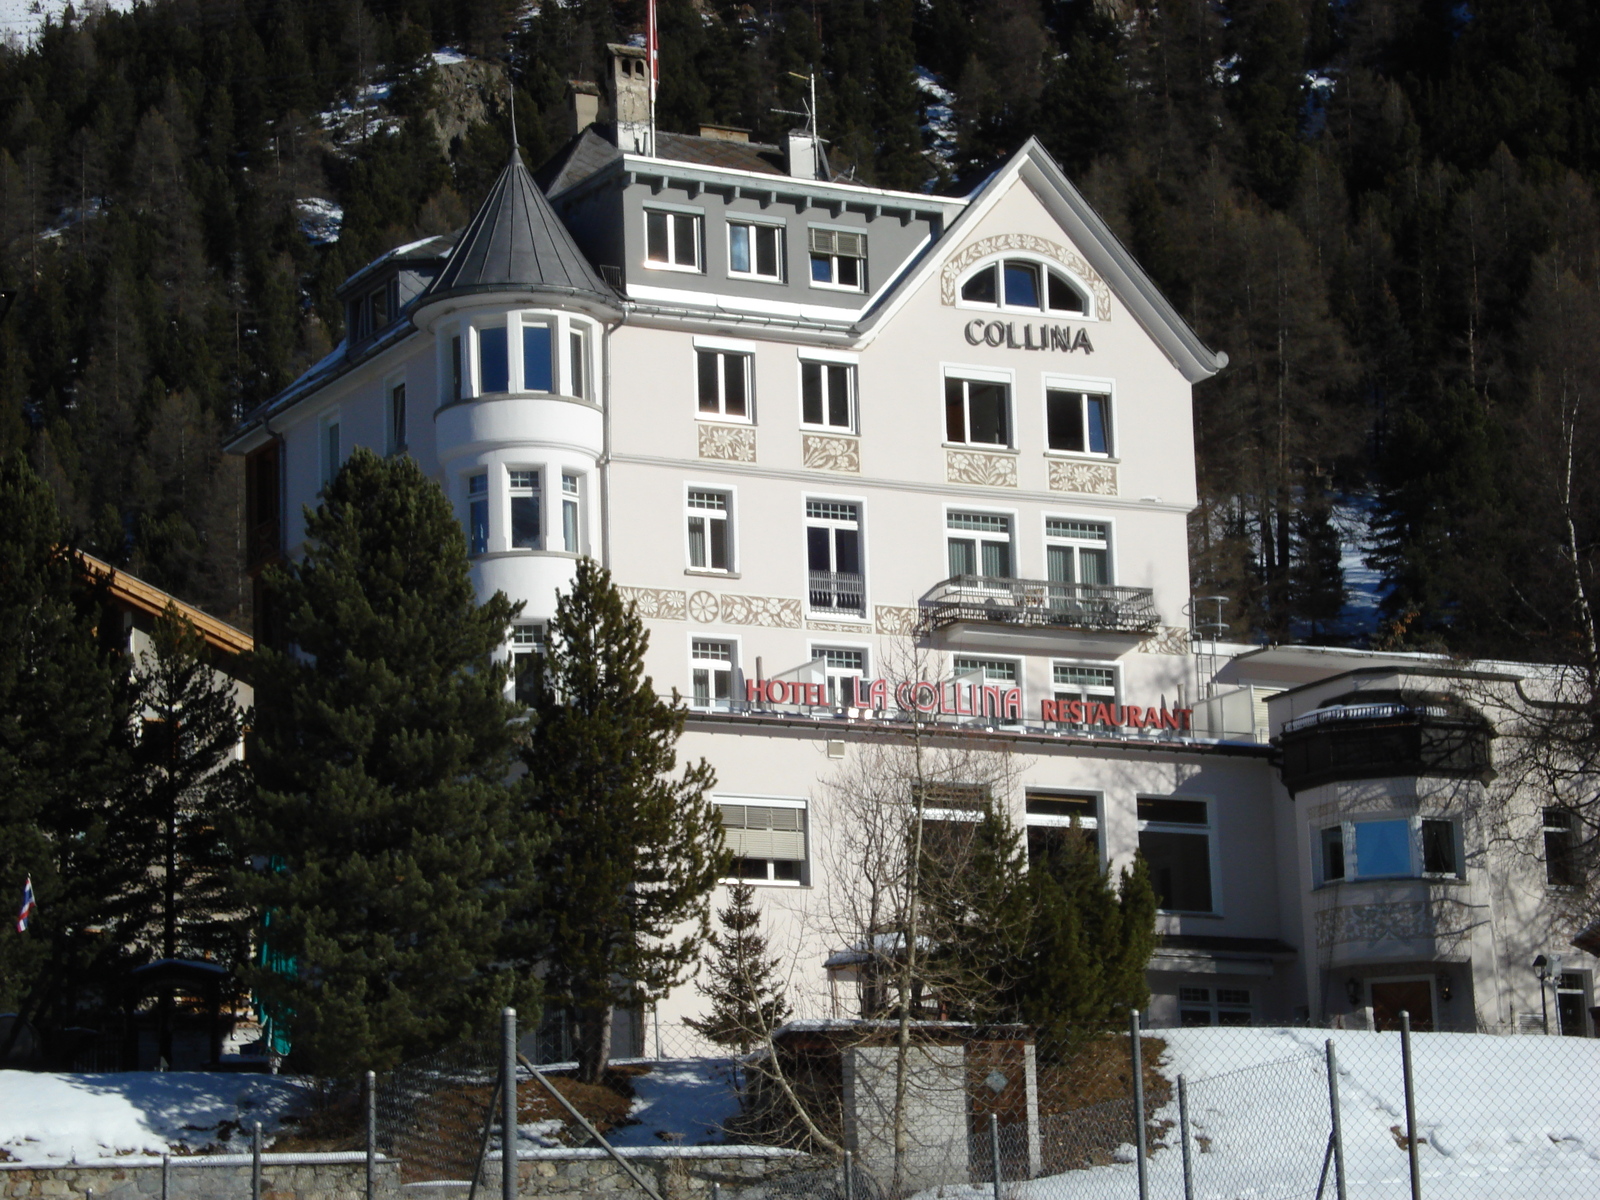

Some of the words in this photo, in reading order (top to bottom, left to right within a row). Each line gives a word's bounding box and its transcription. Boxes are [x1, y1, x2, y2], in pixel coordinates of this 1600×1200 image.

[964, 318, 1094, 355] COLLINA
[746, 678, 830, 707] HOTEL
[853, 675, 887, 710] LA
[897, 680, 1022, 719] COLLINA
[1041, 698, 1193, 730] RESTAURANT
